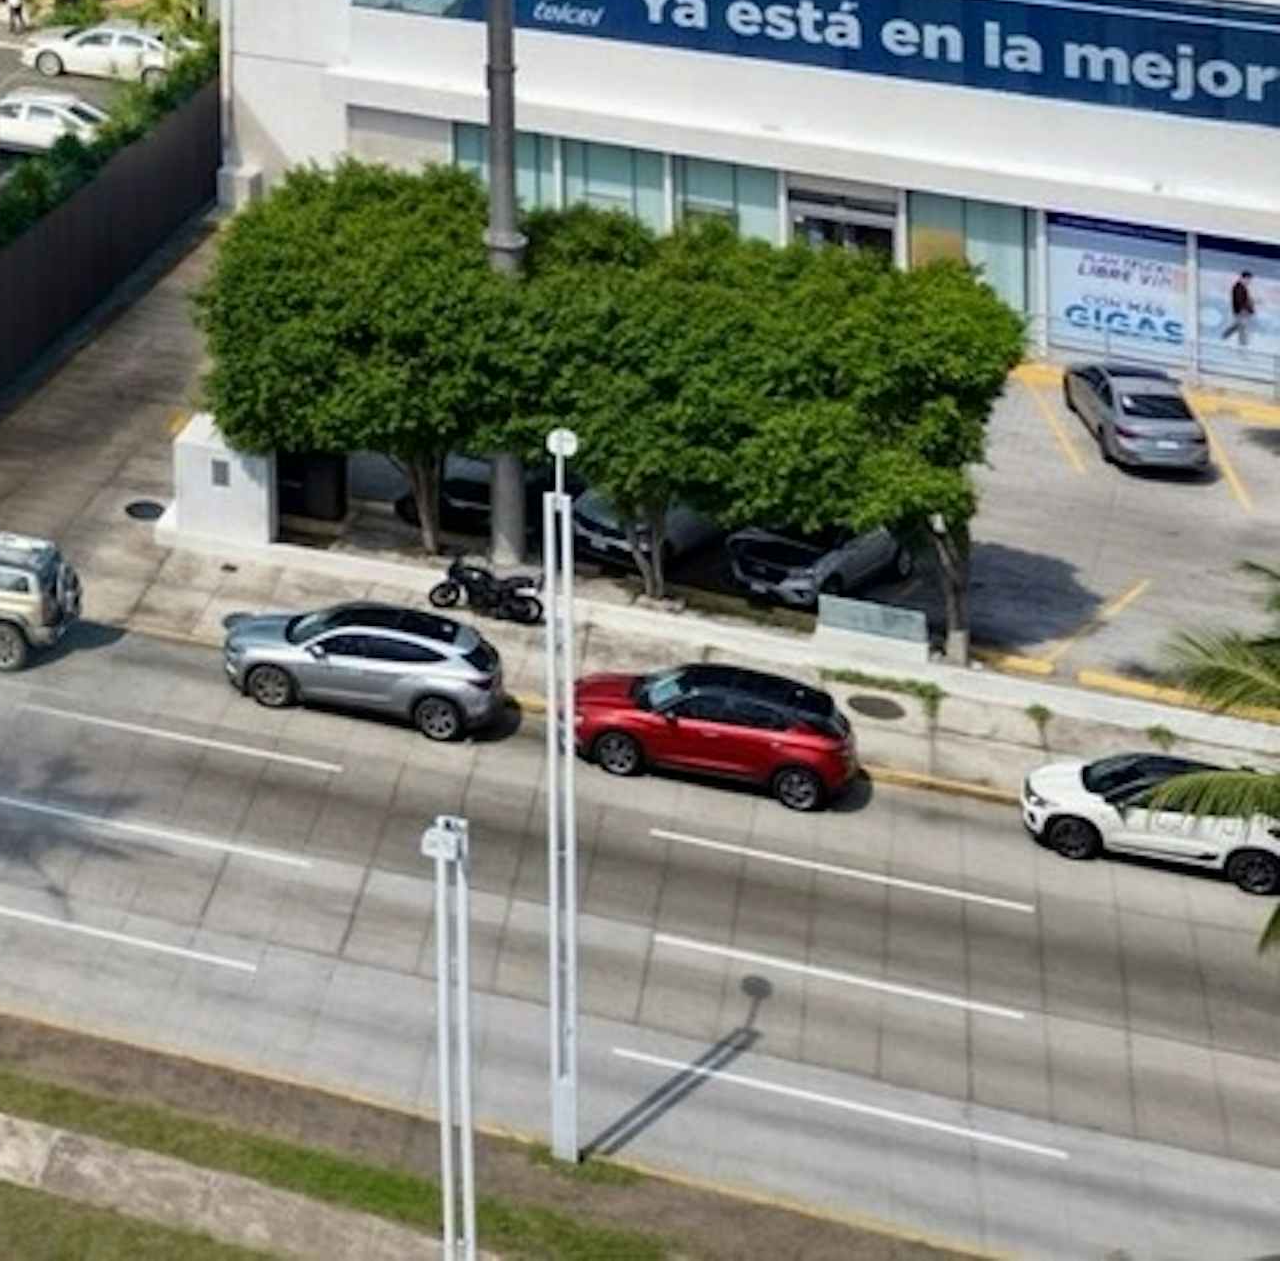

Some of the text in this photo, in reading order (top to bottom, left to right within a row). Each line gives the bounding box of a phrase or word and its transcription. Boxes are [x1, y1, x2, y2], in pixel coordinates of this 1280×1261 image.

[532, 0, 607, 27] telcel
[726, 0, 861, 50] está
[881, 16, 963, 63] en
[983, 21, 1042, 74] la
[1064, 42, 1280, 102] mejor
[1077, 263, 1132, 283] LIBRE
